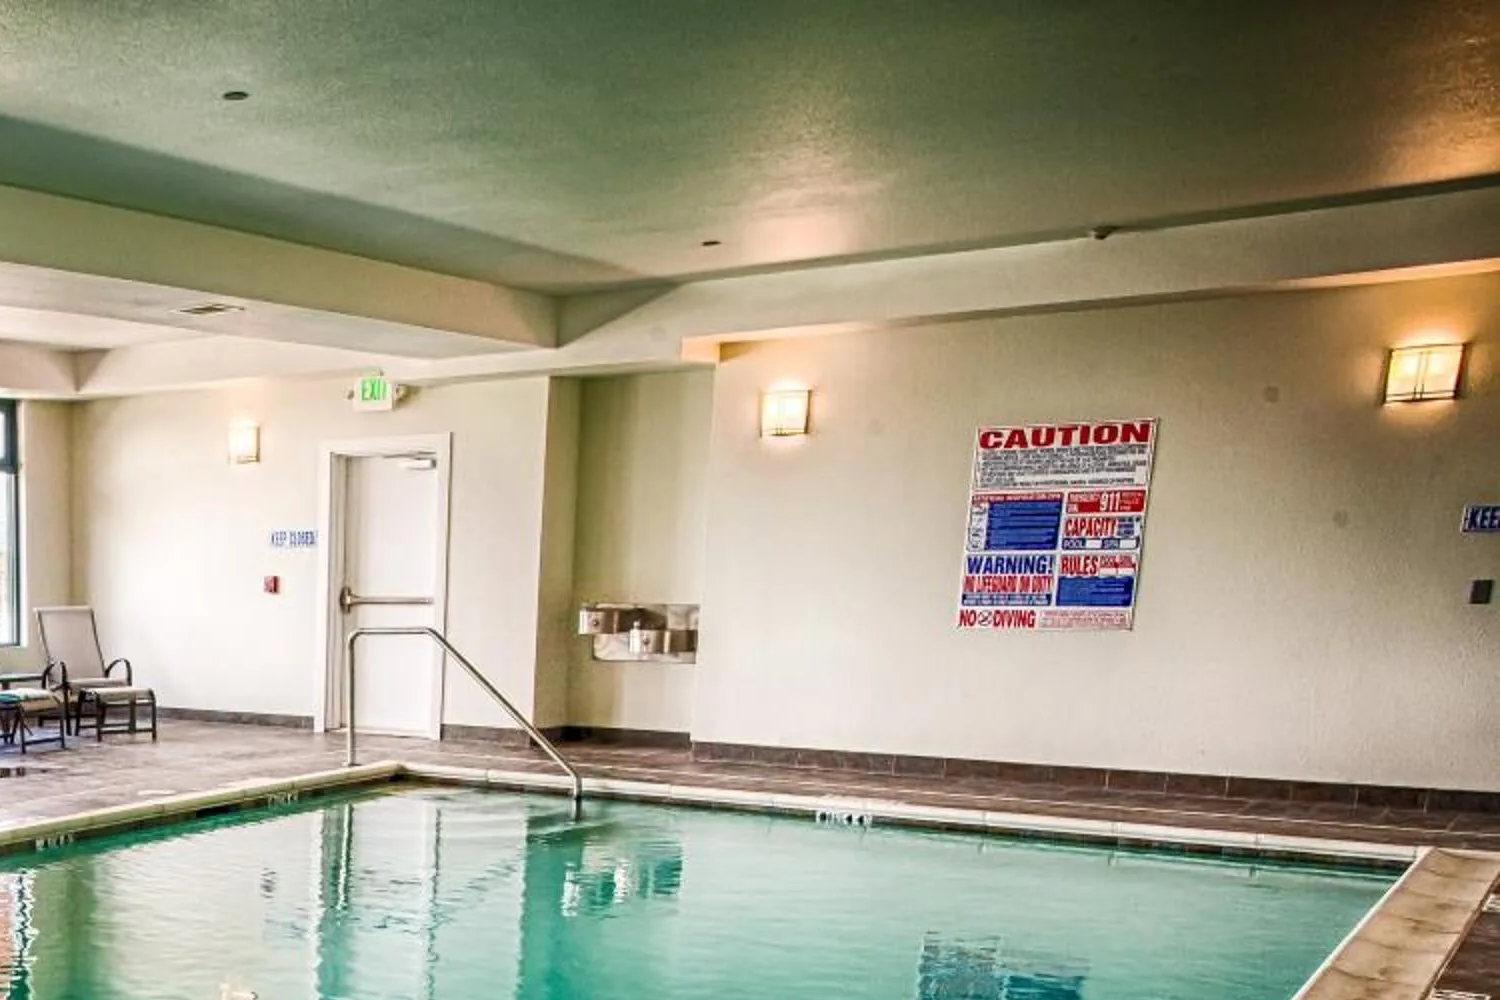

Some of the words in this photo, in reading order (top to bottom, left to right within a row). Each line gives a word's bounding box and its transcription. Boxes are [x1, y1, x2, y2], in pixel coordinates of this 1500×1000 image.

[361, 379, 387, 401] EXIT
[979, 423, 1150, 449] CAUTION
[1100, 491, 1120, 511] 911
[1064, 516, 1116, 537] CAPACITY
[1467, 506, 1500, 529] KEE
[967, 555, 1053, 575] WARNING!
[1060, 554, 1099, 575] RULES
[959, 609, 977, 627] NO
[993, 609, 1037, 628] DIVING
